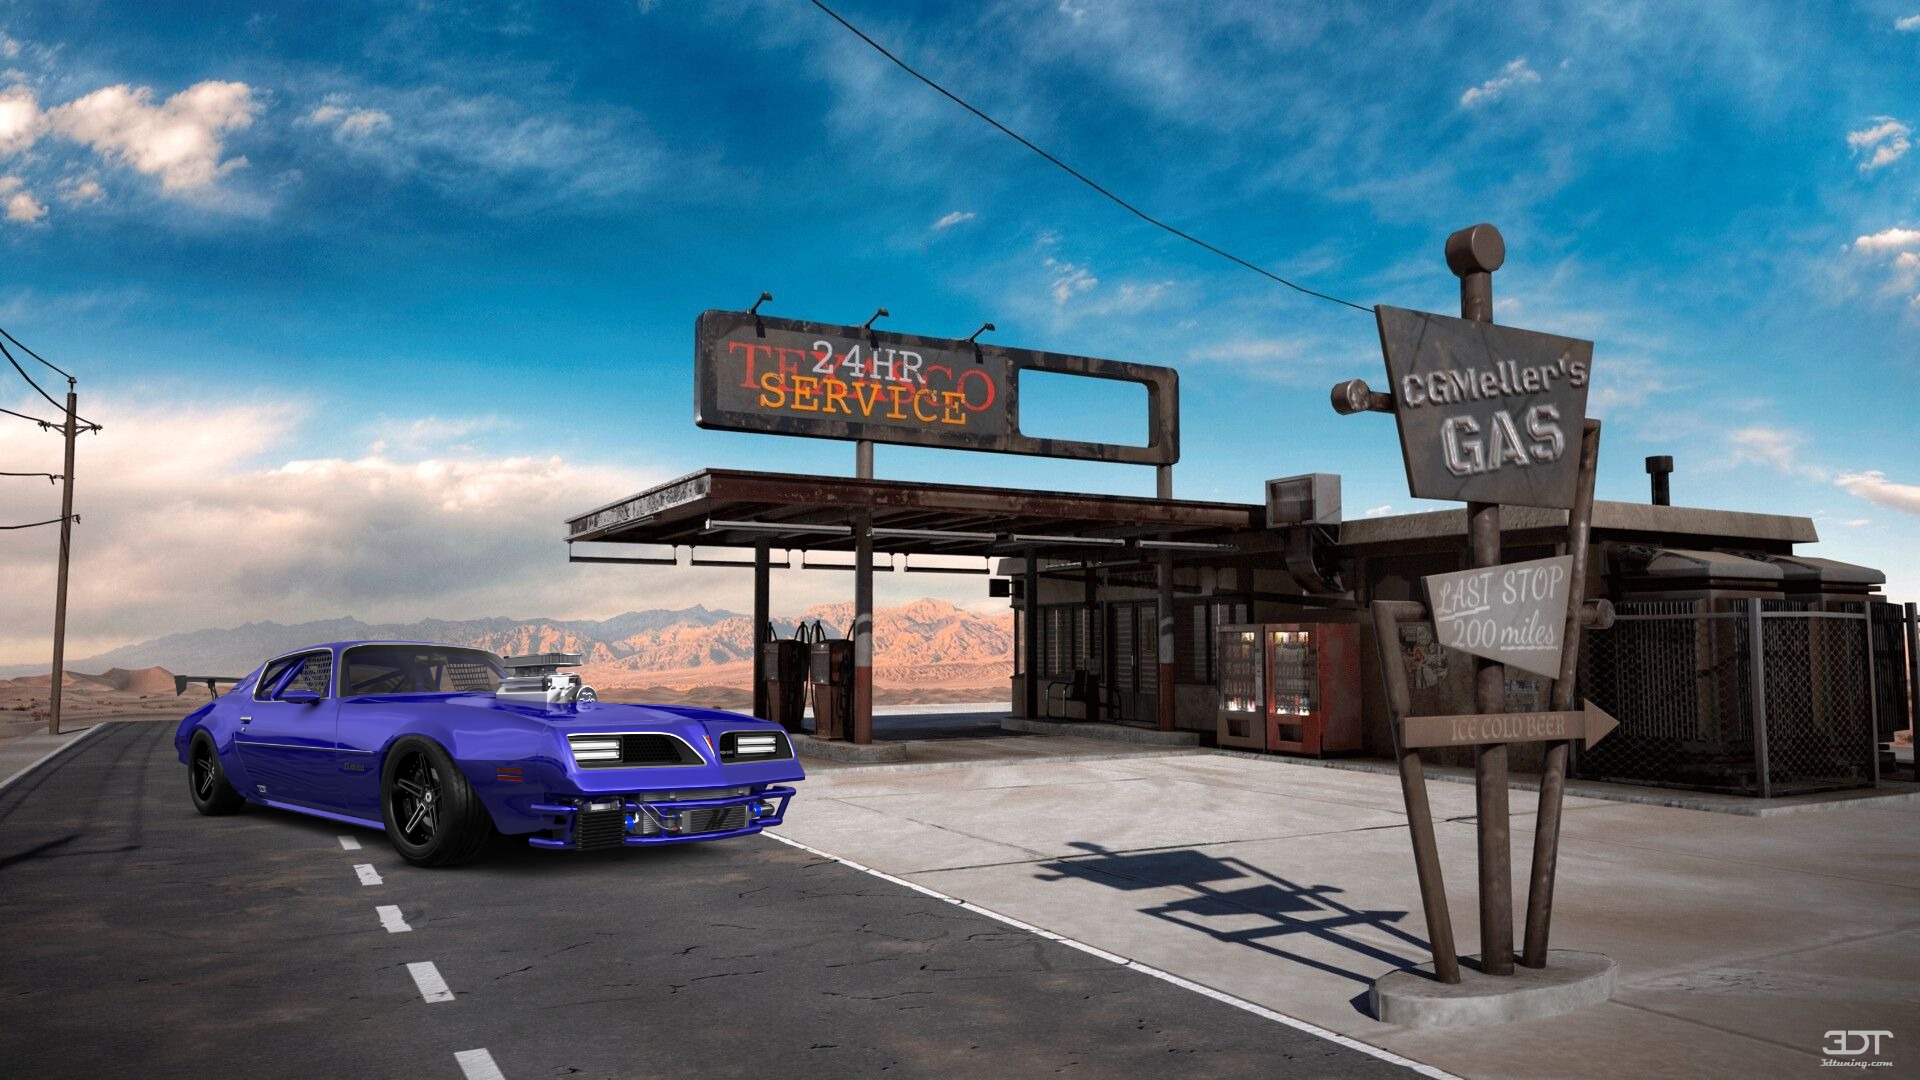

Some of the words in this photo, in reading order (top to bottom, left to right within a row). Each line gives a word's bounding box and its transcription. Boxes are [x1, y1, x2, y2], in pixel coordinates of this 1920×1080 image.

[812, 340, 926, 384] 24HR
[1402, 358, 1588, 408] CGMeller's
[759, 371, 967, 426] SERVICE
[1440, 404, 1565, 478] GAS
[1438, 572, 1494, 615] LAST
[1502, 564, 1564, 604] STOP
[1452, 618, 1498, 649] 200
[1500, 609, 1556, 646] miles
[1451, 716, 1476, 741] ICE
[1480, 715, 1523, 740] COLD
[1526, 714, 1566, 737] BEER
